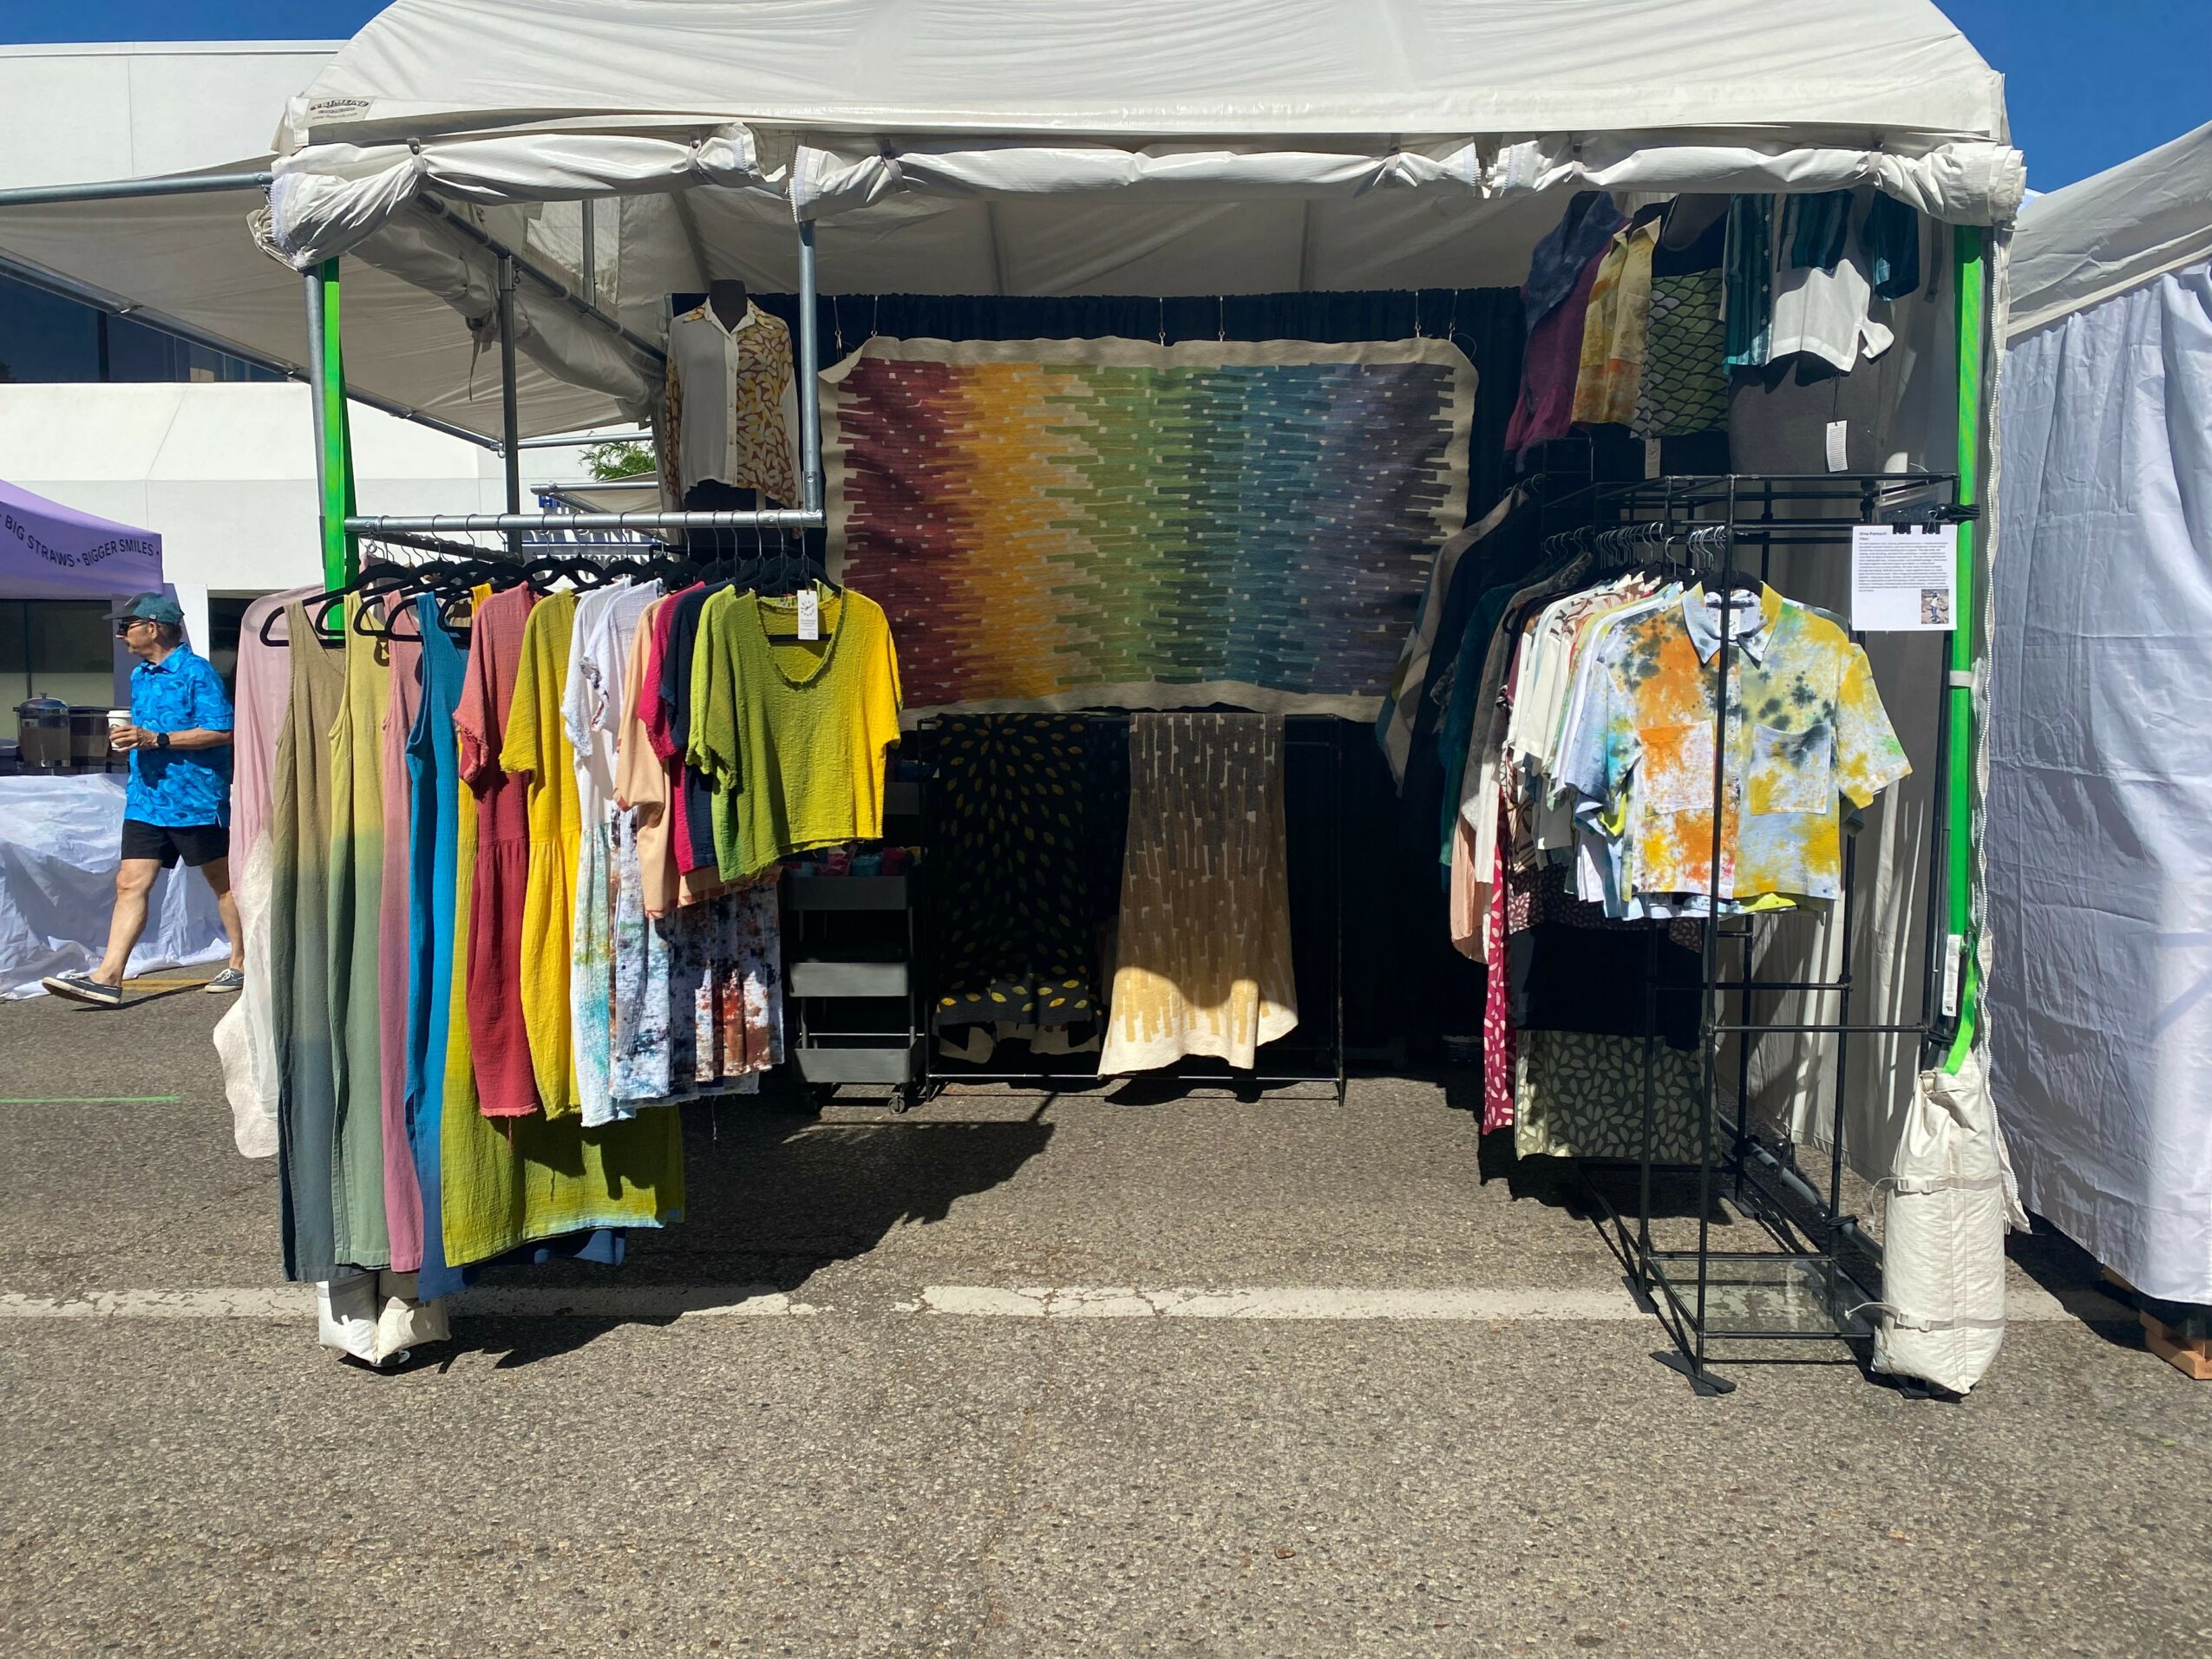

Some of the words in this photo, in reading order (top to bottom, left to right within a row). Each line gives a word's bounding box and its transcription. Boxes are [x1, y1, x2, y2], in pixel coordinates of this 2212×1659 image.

[5, 514, 25, 540] BIG
[28, 535, 75, 567] STRAWS
[82, 540, 118, 566] BIGGER
[119, 539, 154, 557] SMILES
